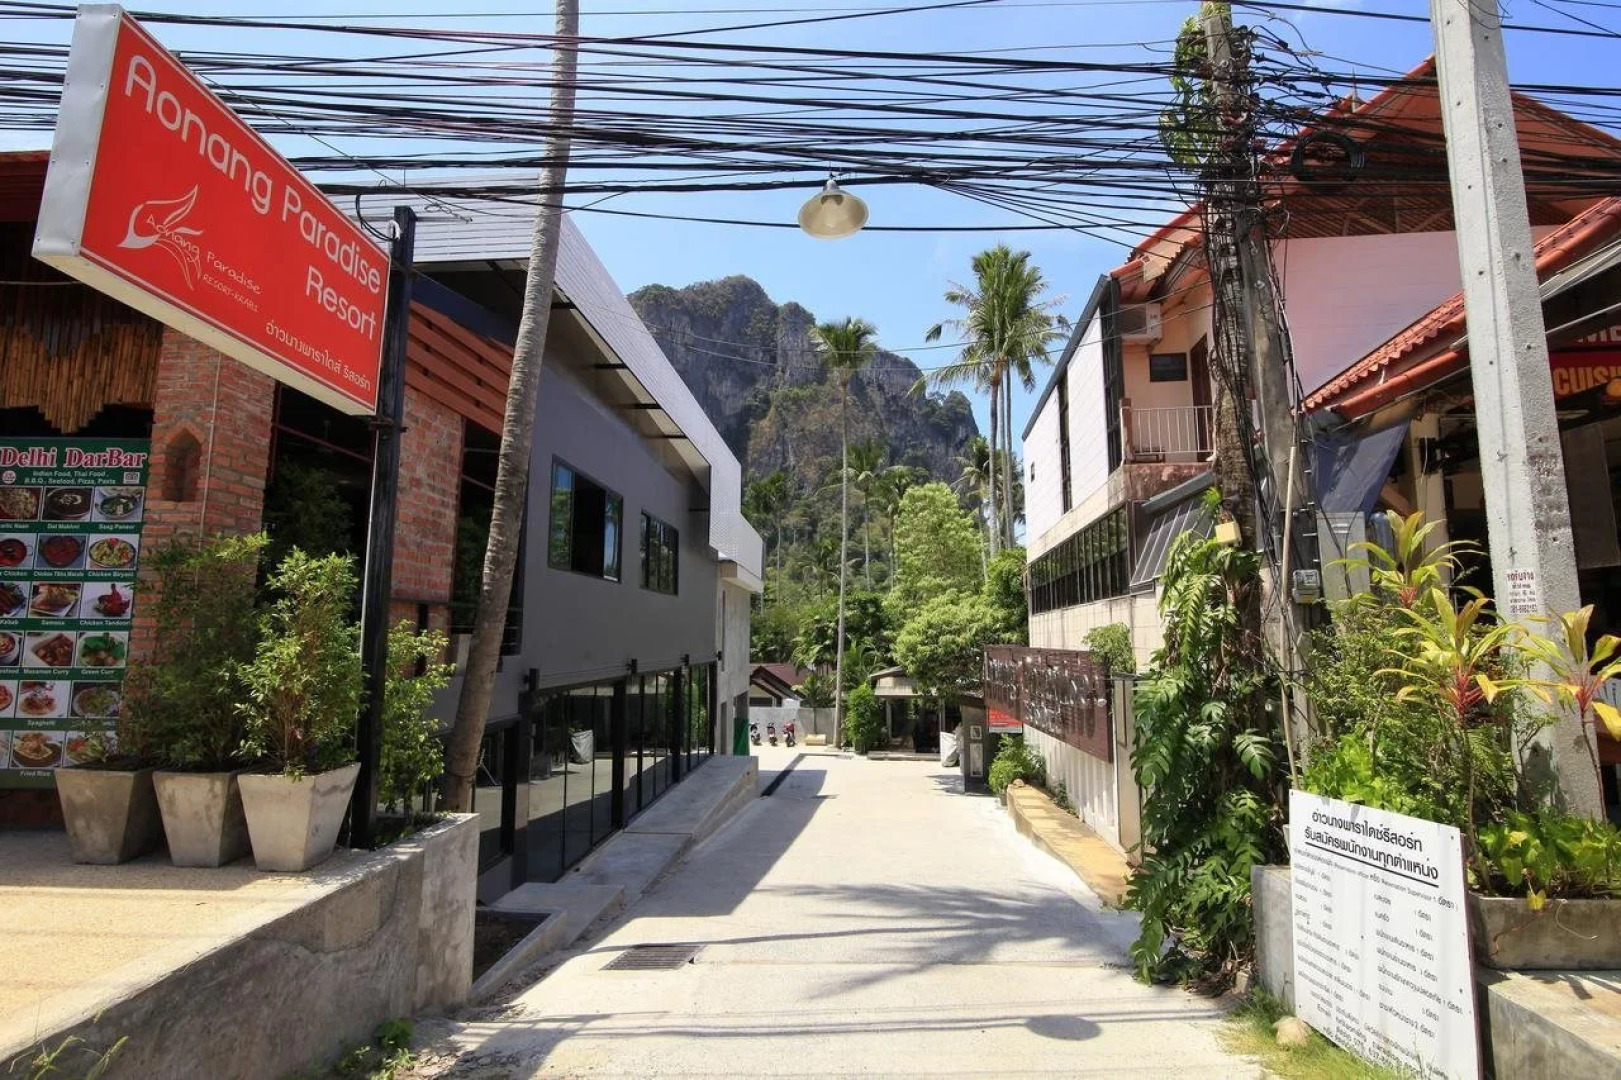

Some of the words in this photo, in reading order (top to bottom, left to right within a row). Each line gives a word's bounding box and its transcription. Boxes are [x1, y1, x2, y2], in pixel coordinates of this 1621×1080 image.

[125, 55, 273, 215] Aonang
[281, 184, 381, 294] Paradise
[146, 213, 200, 262] Aonang
[207, 251, 261, 295] Paradise
[305, 265, 376, 340] Resort
[0, 446, 58, 468] Delhi
[63, 447, 148, 469] DarBar
